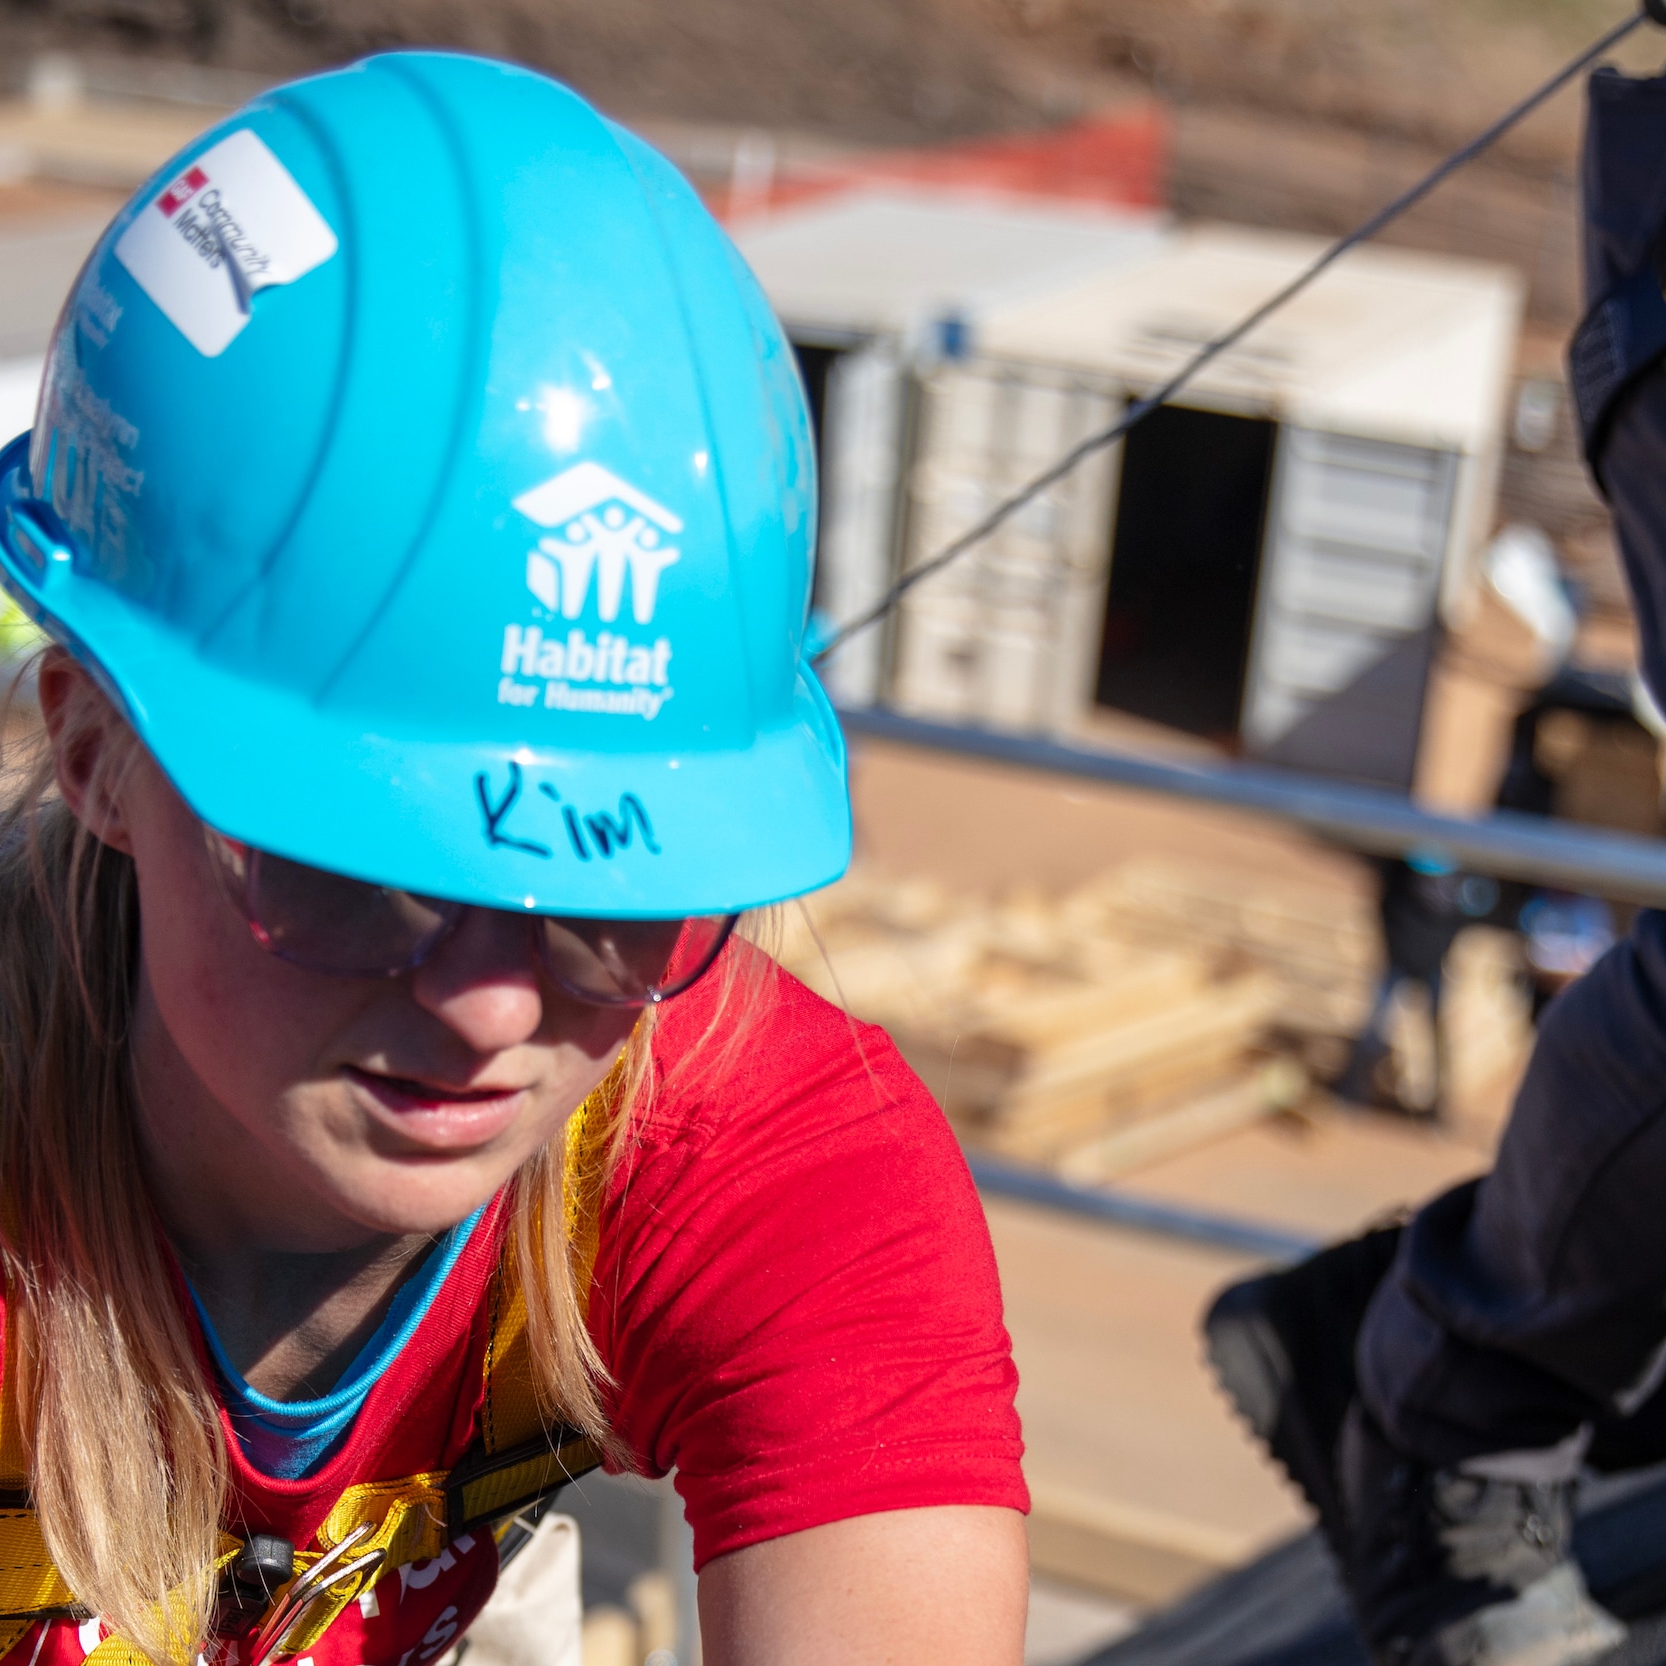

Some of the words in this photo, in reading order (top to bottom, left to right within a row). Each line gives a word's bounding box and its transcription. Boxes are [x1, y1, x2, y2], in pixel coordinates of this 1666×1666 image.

[173, 207, 226, 270] Matters
[500, 623, 673, 687] Habitat
[497, 676, 539, 707] for
[473, 761, 662, 861] Kim
